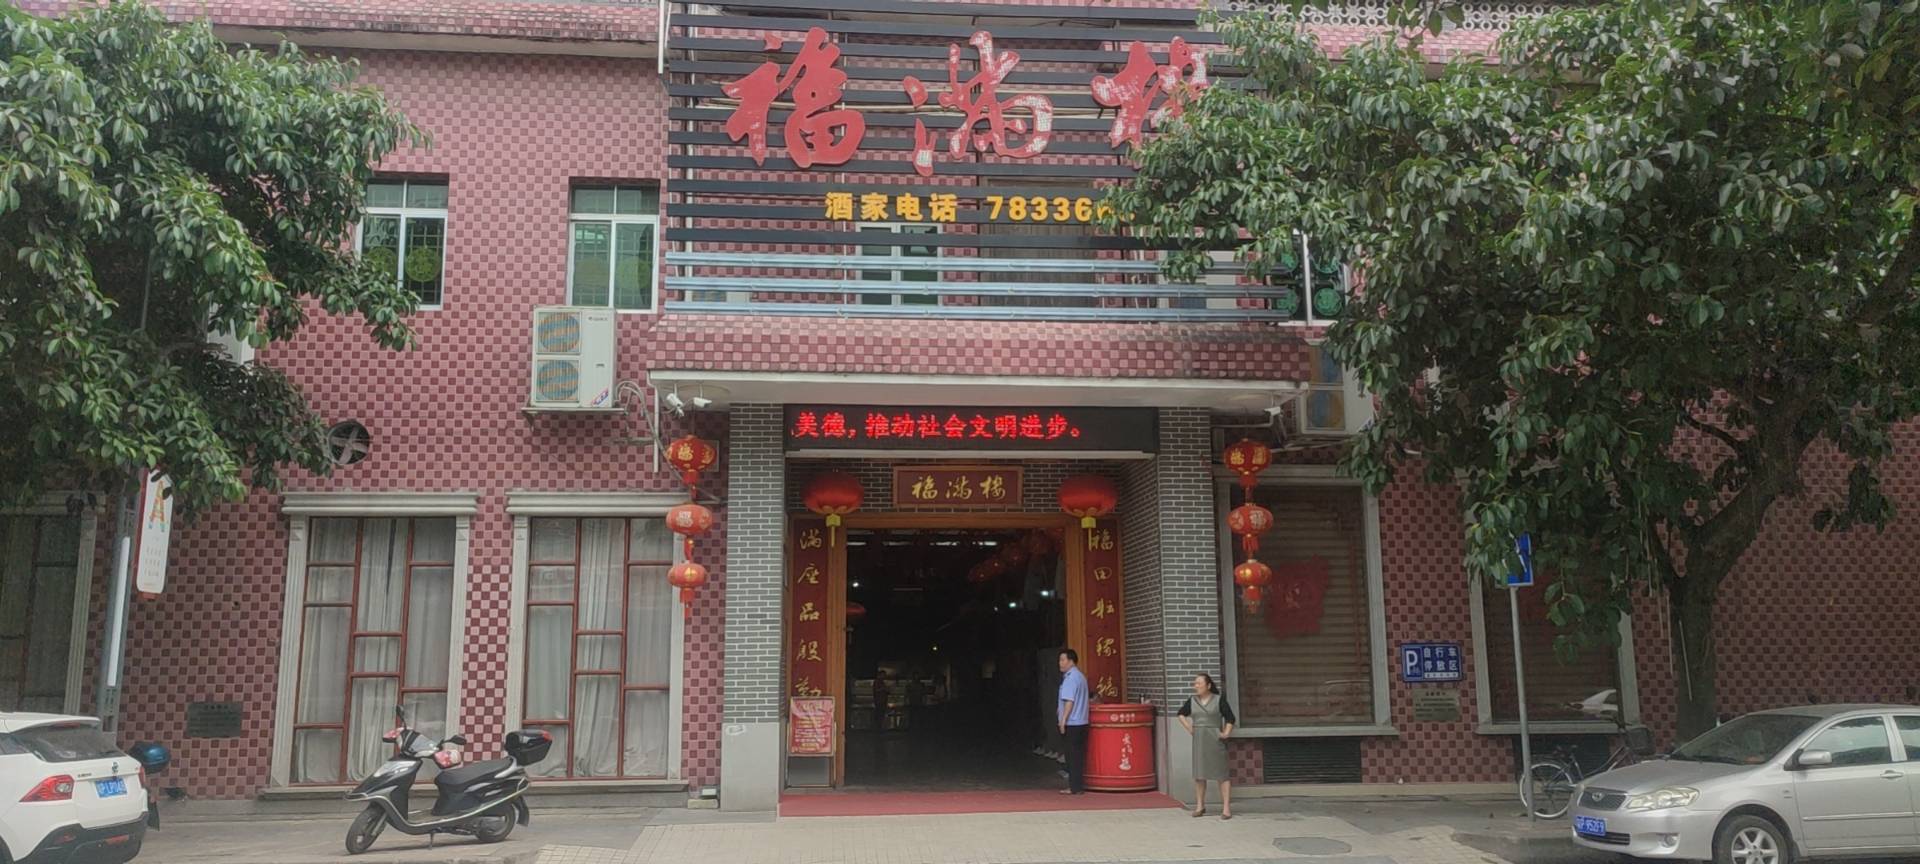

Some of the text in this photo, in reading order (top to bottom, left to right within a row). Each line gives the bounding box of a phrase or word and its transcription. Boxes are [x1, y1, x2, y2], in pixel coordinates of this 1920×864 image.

[824, 191, 1136, 223] 酒家电话 78336
[791, 411, 1081, 439] 美德，推动社会文明进步。
[1423, 647, 1458, 658] 自行车
